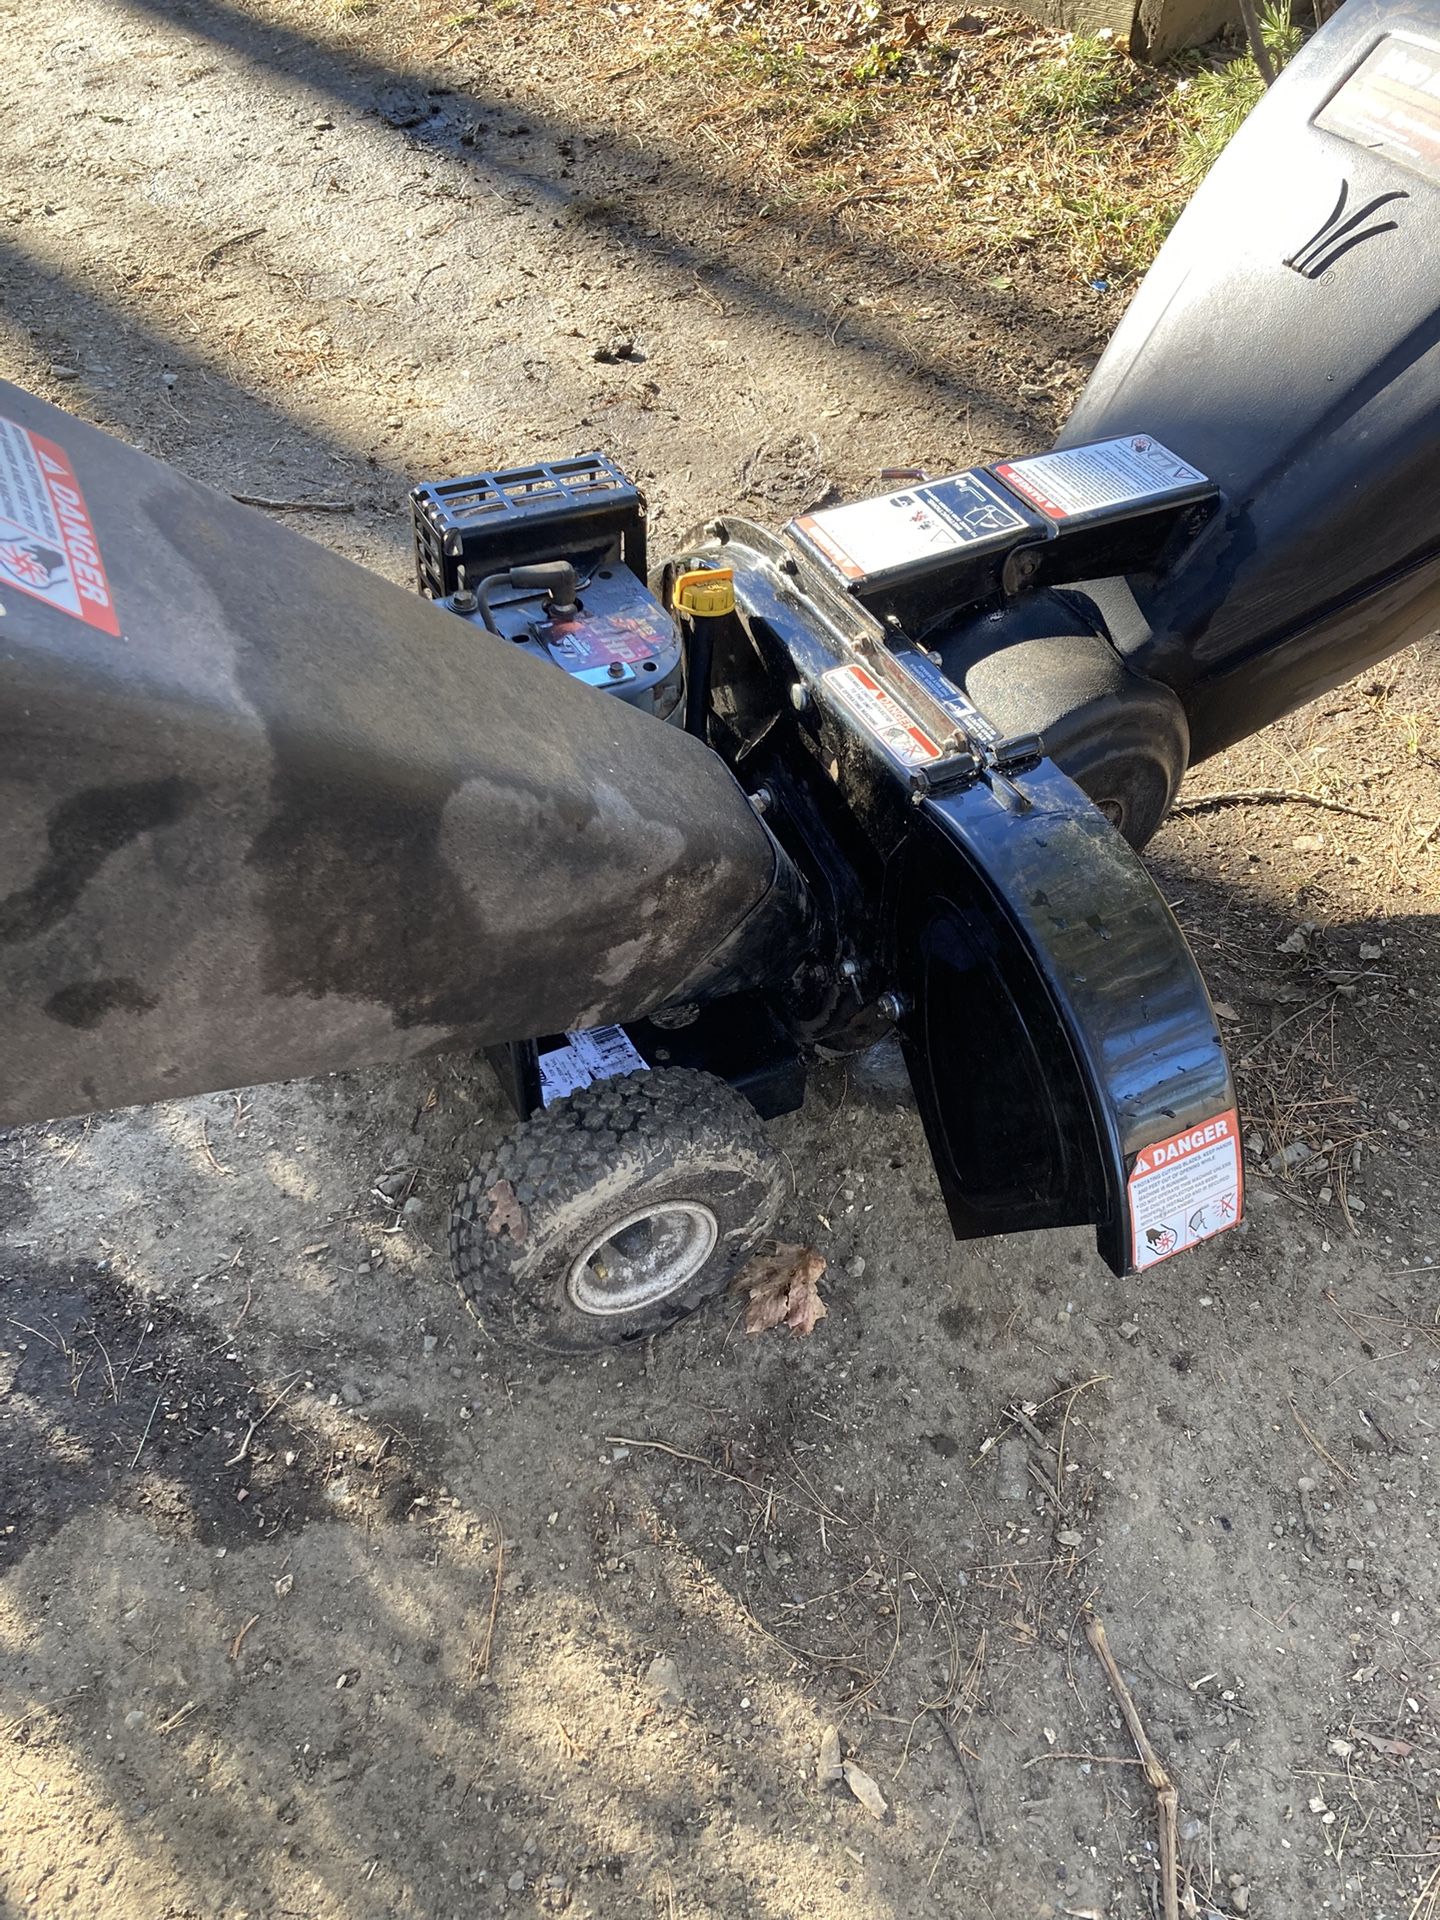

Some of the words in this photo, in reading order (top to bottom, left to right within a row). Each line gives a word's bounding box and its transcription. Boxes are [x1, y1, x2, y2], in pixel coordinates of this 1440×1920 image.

[11, 465, 24, 486] AND
[1006, 471, 1047, 504] DANGER
[17, 485, 33, 511] FEET
[26, 463, 46, 502] CUTTING
[38, 500, 58, 540] BLADES
[23, 509, 39, 532] OUT
[50, 479, 109, 607] DANGER
[880, 696, 913, 729] DANGER
[1152, 1120, 1228, 1166] DANGER
[1148, 1180, 1159, 1190] FEET
[1179, 1162, 1200, 1175] OPENING
[1201, 1155, 1215, 1165] WHILE
[1161, 1164, 1181, 1177] CUTTING
[1202, 1148, 1214, 1157] KEEP
[1157, 1186, 1179, 1200] OPERATE
